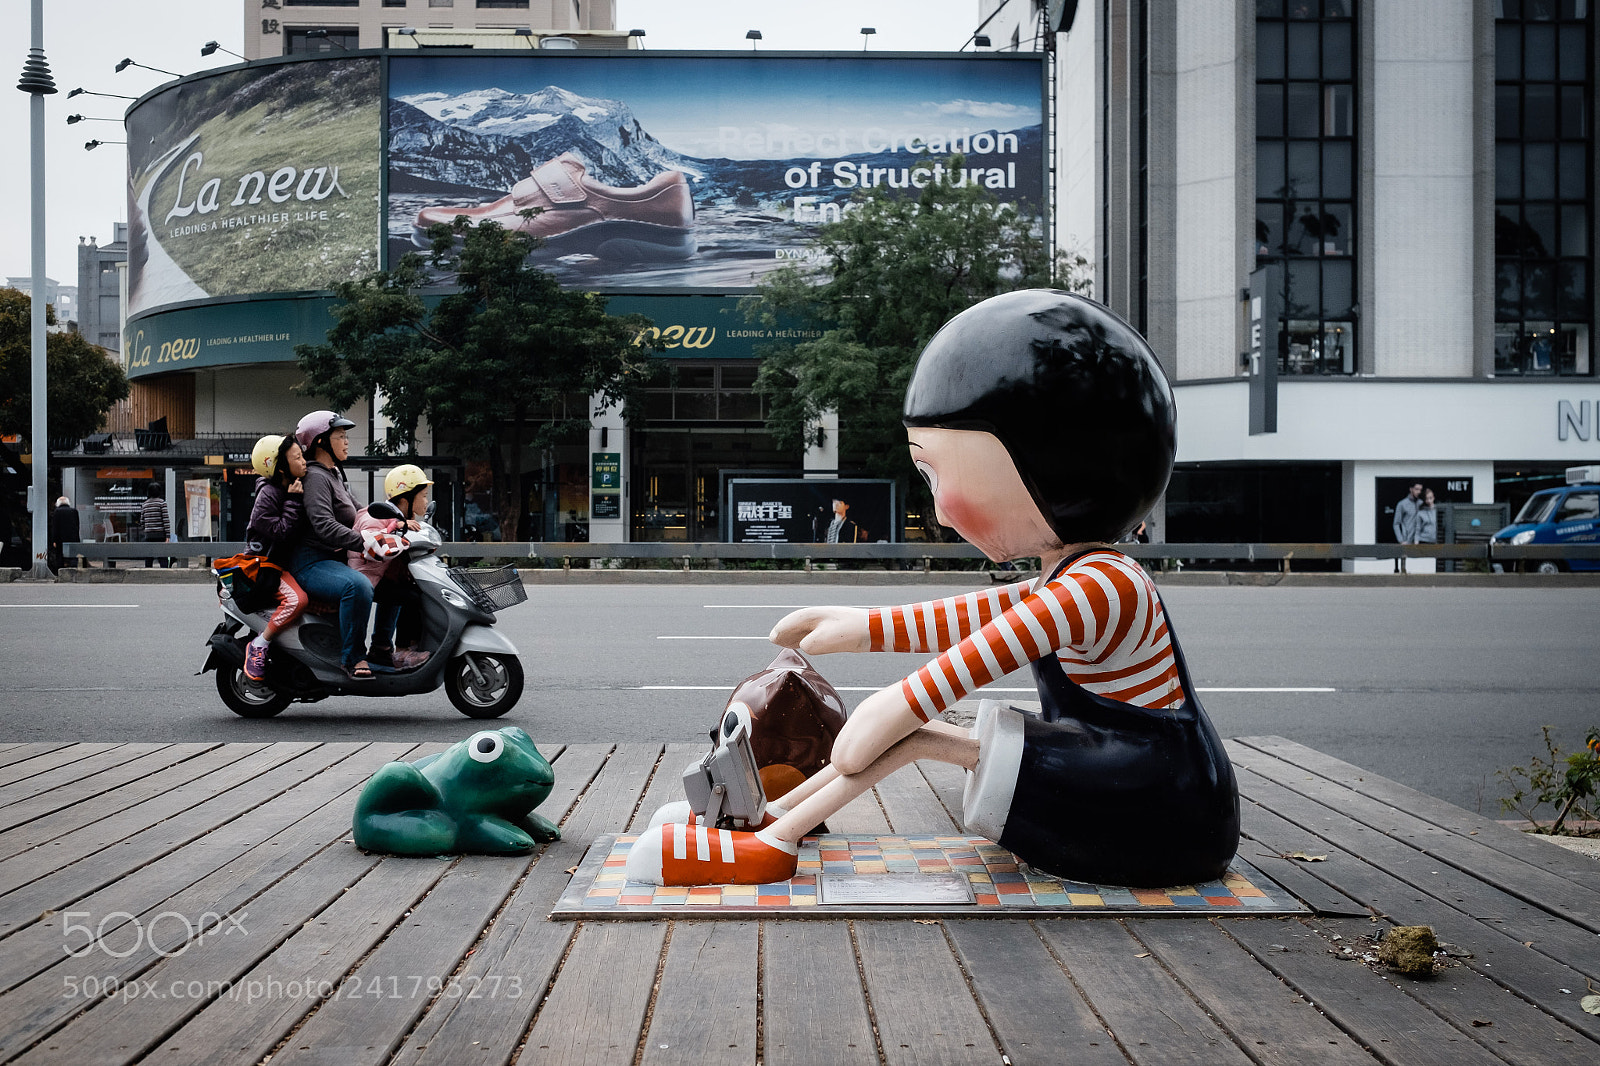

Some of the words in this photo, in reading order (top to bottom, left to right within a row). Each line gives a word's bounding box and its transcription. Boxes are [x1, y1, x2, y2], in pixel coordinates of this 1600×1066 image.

[862, 127, 1019, 154] Creation
[164, 151, 222, 226] La
[230, 166, 340, 207] new
[784, 161, 822, 189] of
[833, 161, 1016, 189] Structural
[170, 223, 207, 239] LEADING
[211, 221, 218, 230] A
[221, 212, 289, 229] HEALTHIER
[296, 210, 329, 221] LIFE
[131, 329, 151, 369] La
[157, 338, 201, 363] new
[206, 338, 232, 347] LEADING
[233, 336, 238, 344] A
[238, 334, 274, 343] HEALTHIER
[275, 333, 290, 341] LIFE
[631, 325, 716, 349] new
[726, 329, 765, 338] LEADING
[766, 330, 773, 338] A
[775, 329, 822, 338] HEALTHIER
[1251, 296, 1262, 376] ET
[1557, 400, 1600, 441] N
[603, 473, 610, 482] P
[1447, 481, 1470, 492] NET
